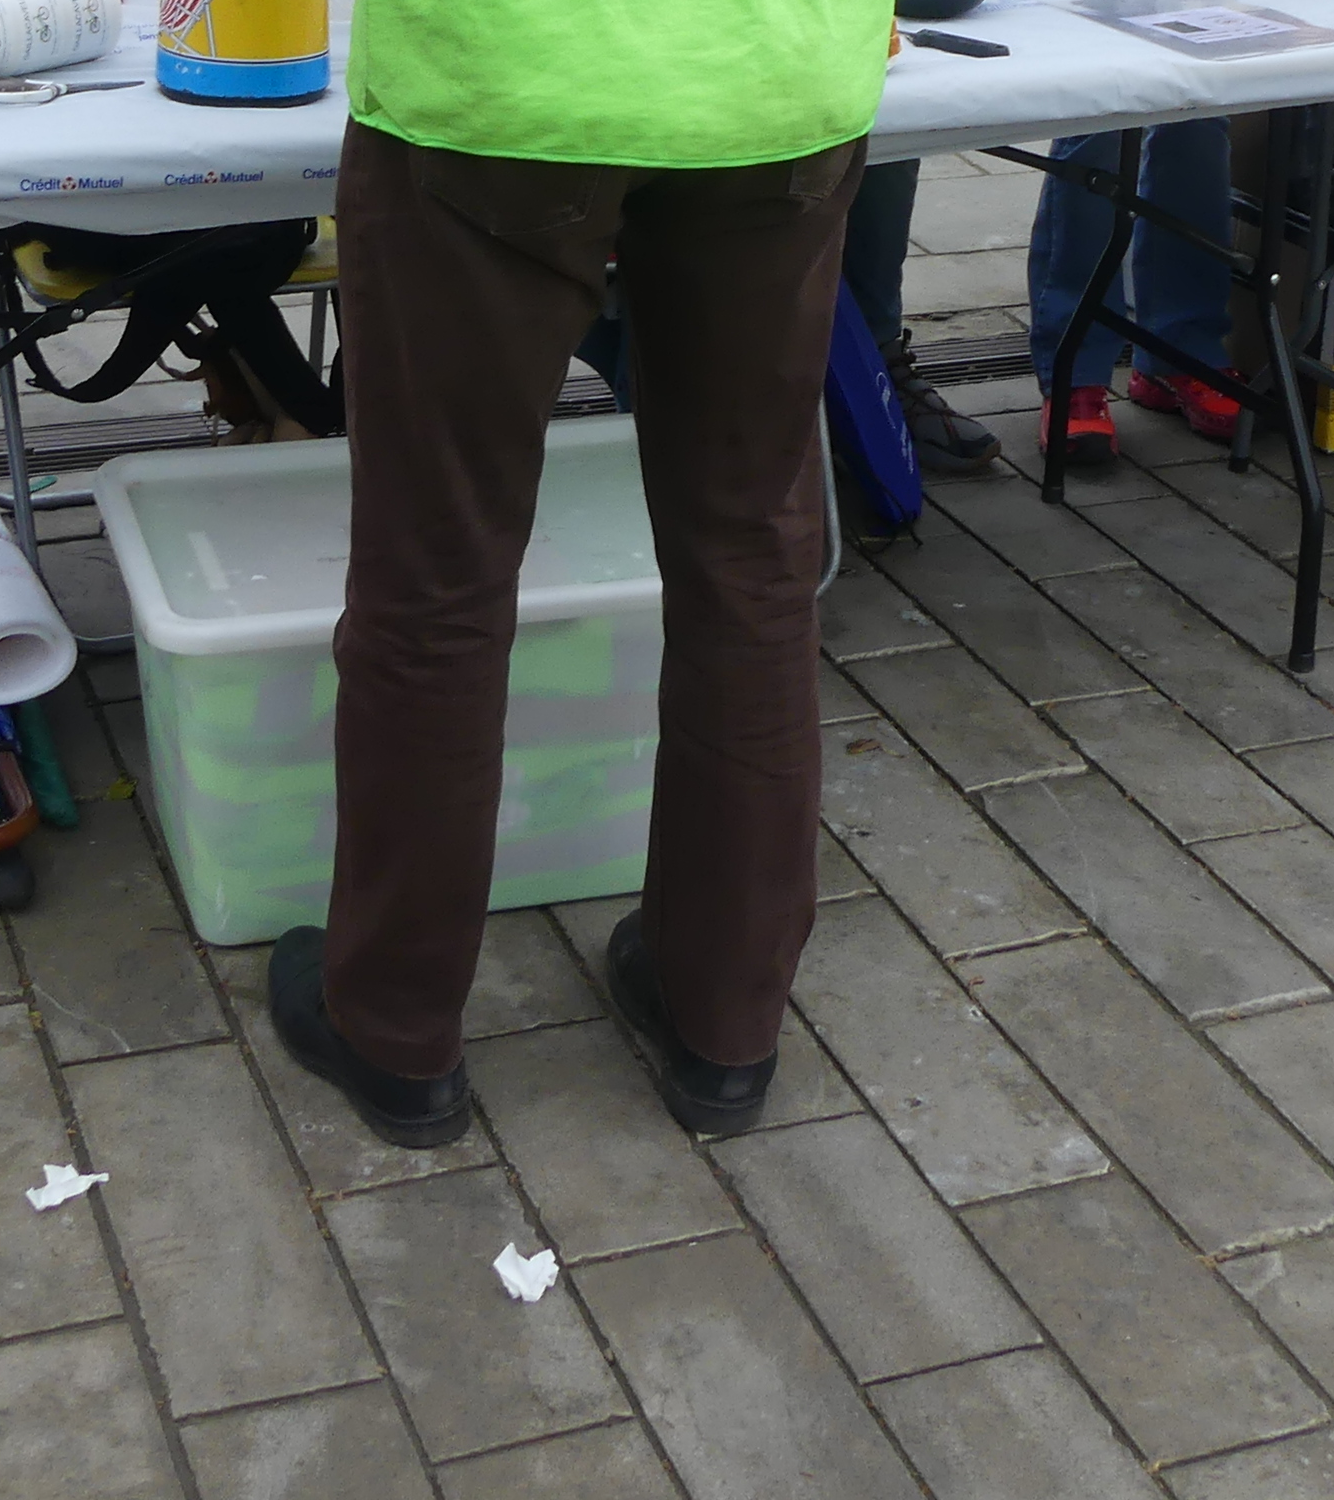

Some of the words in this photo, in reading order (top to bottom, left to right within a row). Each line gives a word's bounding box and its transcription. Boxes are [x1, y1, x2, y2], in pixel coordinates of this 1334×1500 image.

[20, 177, 61, 191] Crédit
[78, 176, 125, 189] Mutuel
[164, 173, 203, 187] Crédit
[220, 171, 264, 184] Mutuel
